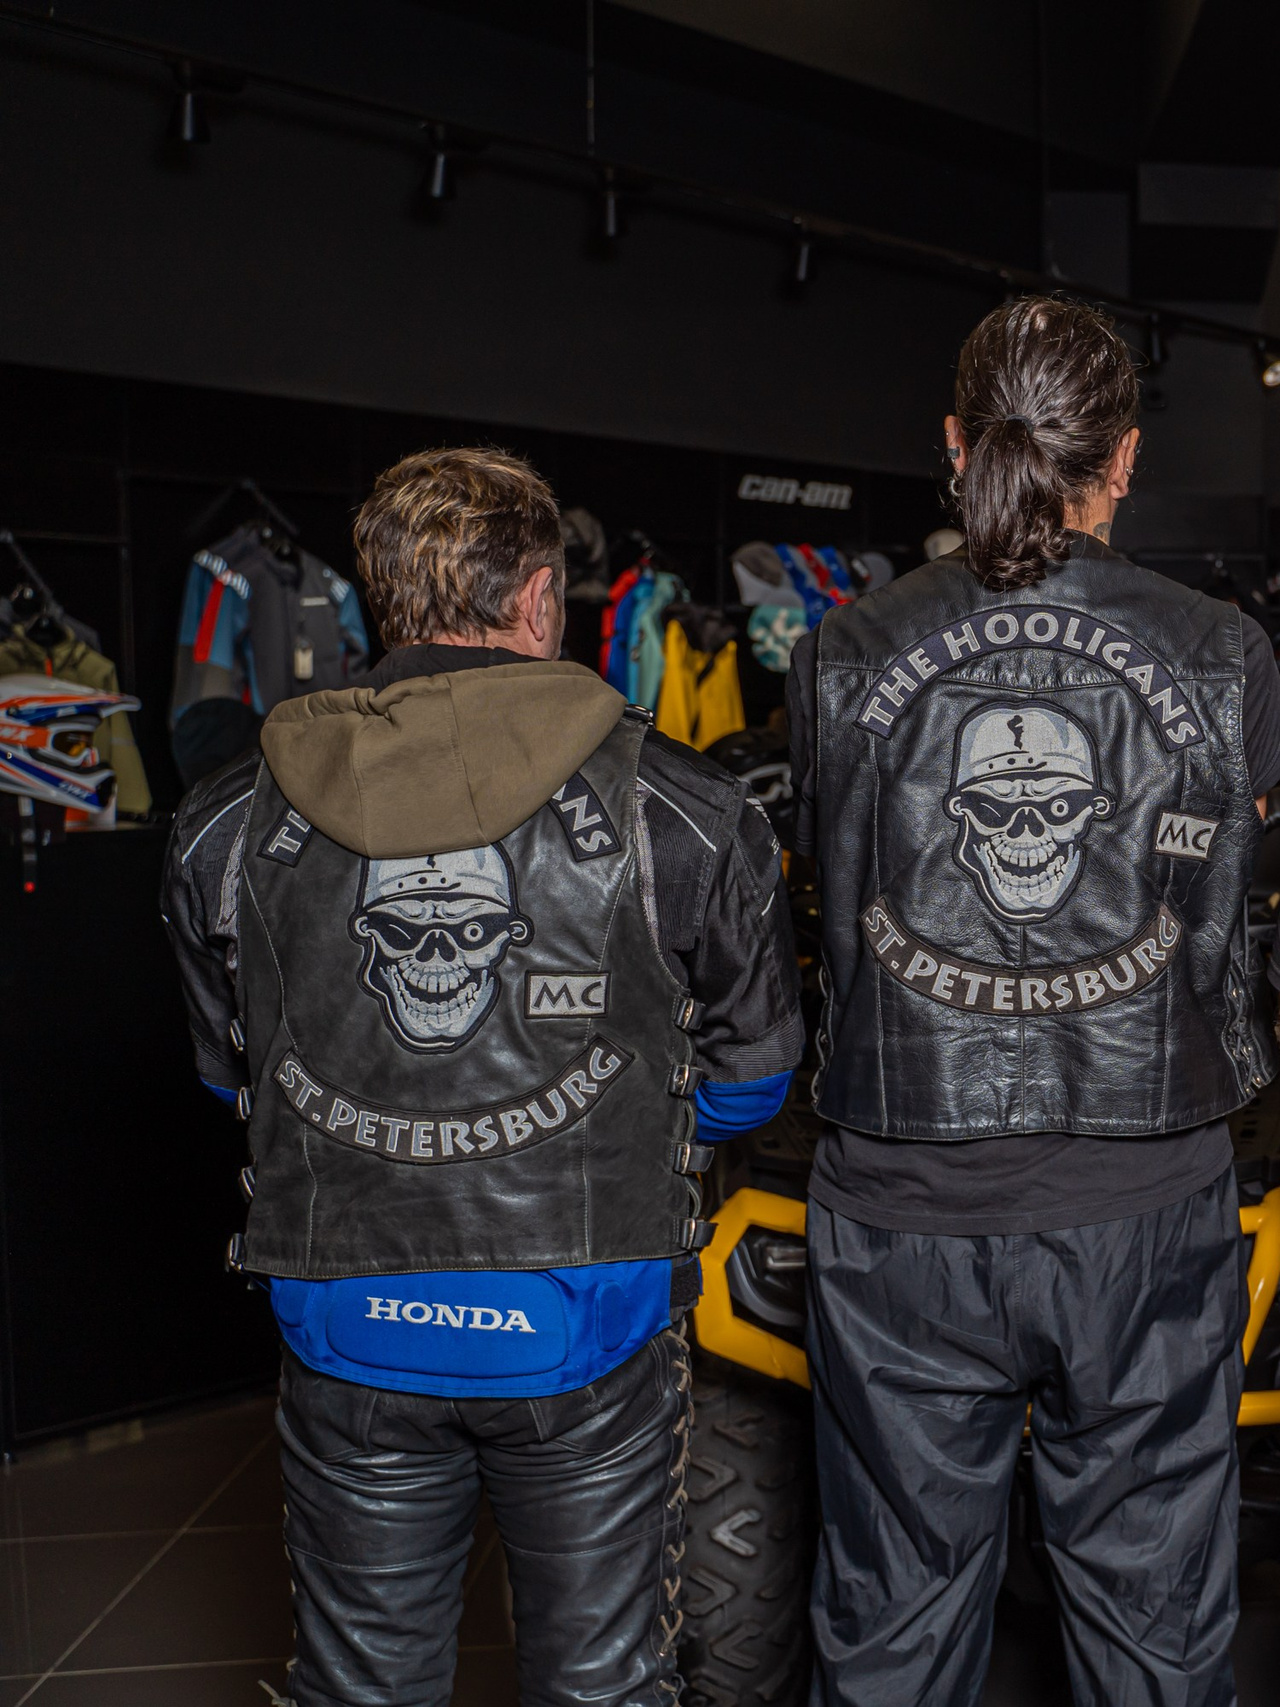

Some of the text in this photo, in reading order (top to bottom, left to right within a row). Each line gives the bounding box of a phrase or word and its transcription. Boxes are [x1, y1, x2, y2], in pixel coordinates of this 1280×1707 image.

[862, 612, 1198, 746] THE HOOLIGANS
[1158, 821, 1213, 854] MC
[532, 979, 606, 1011] MC
[364, 1296, 537, 1334] HONDA
